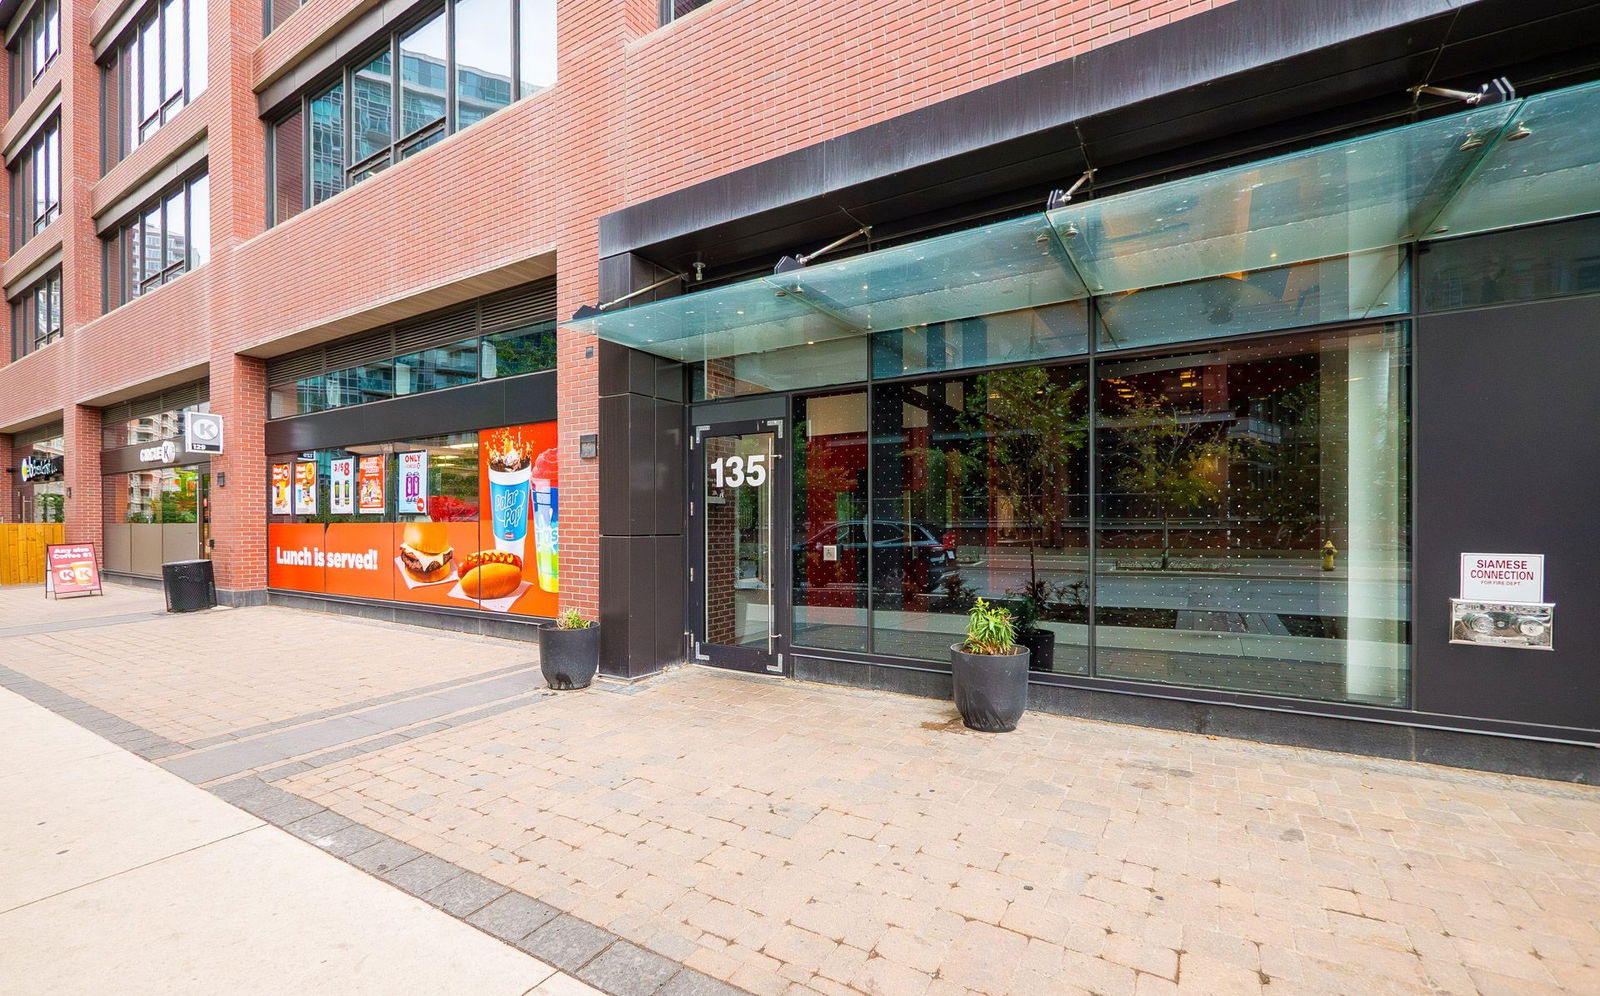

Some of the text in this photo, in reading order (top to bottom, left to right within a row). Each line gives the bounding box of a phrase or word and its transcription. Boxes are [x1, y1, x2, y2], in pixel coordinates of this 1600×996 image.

[199, 423, 215, 438] K
[140, 447, 163, 463] CIRCLE
[404, 454, 422, 463] ONLY
[710, 454, 766, 488] 135
[495, 489, 518, 512] Polar
[503, 507, 523, 528] Pop
[276, 546, 378, 570] Lunch is served!
[1476, 560, 1528, 570] SIAMESE
[1470, 570, 1534, 580] CONNECTION
